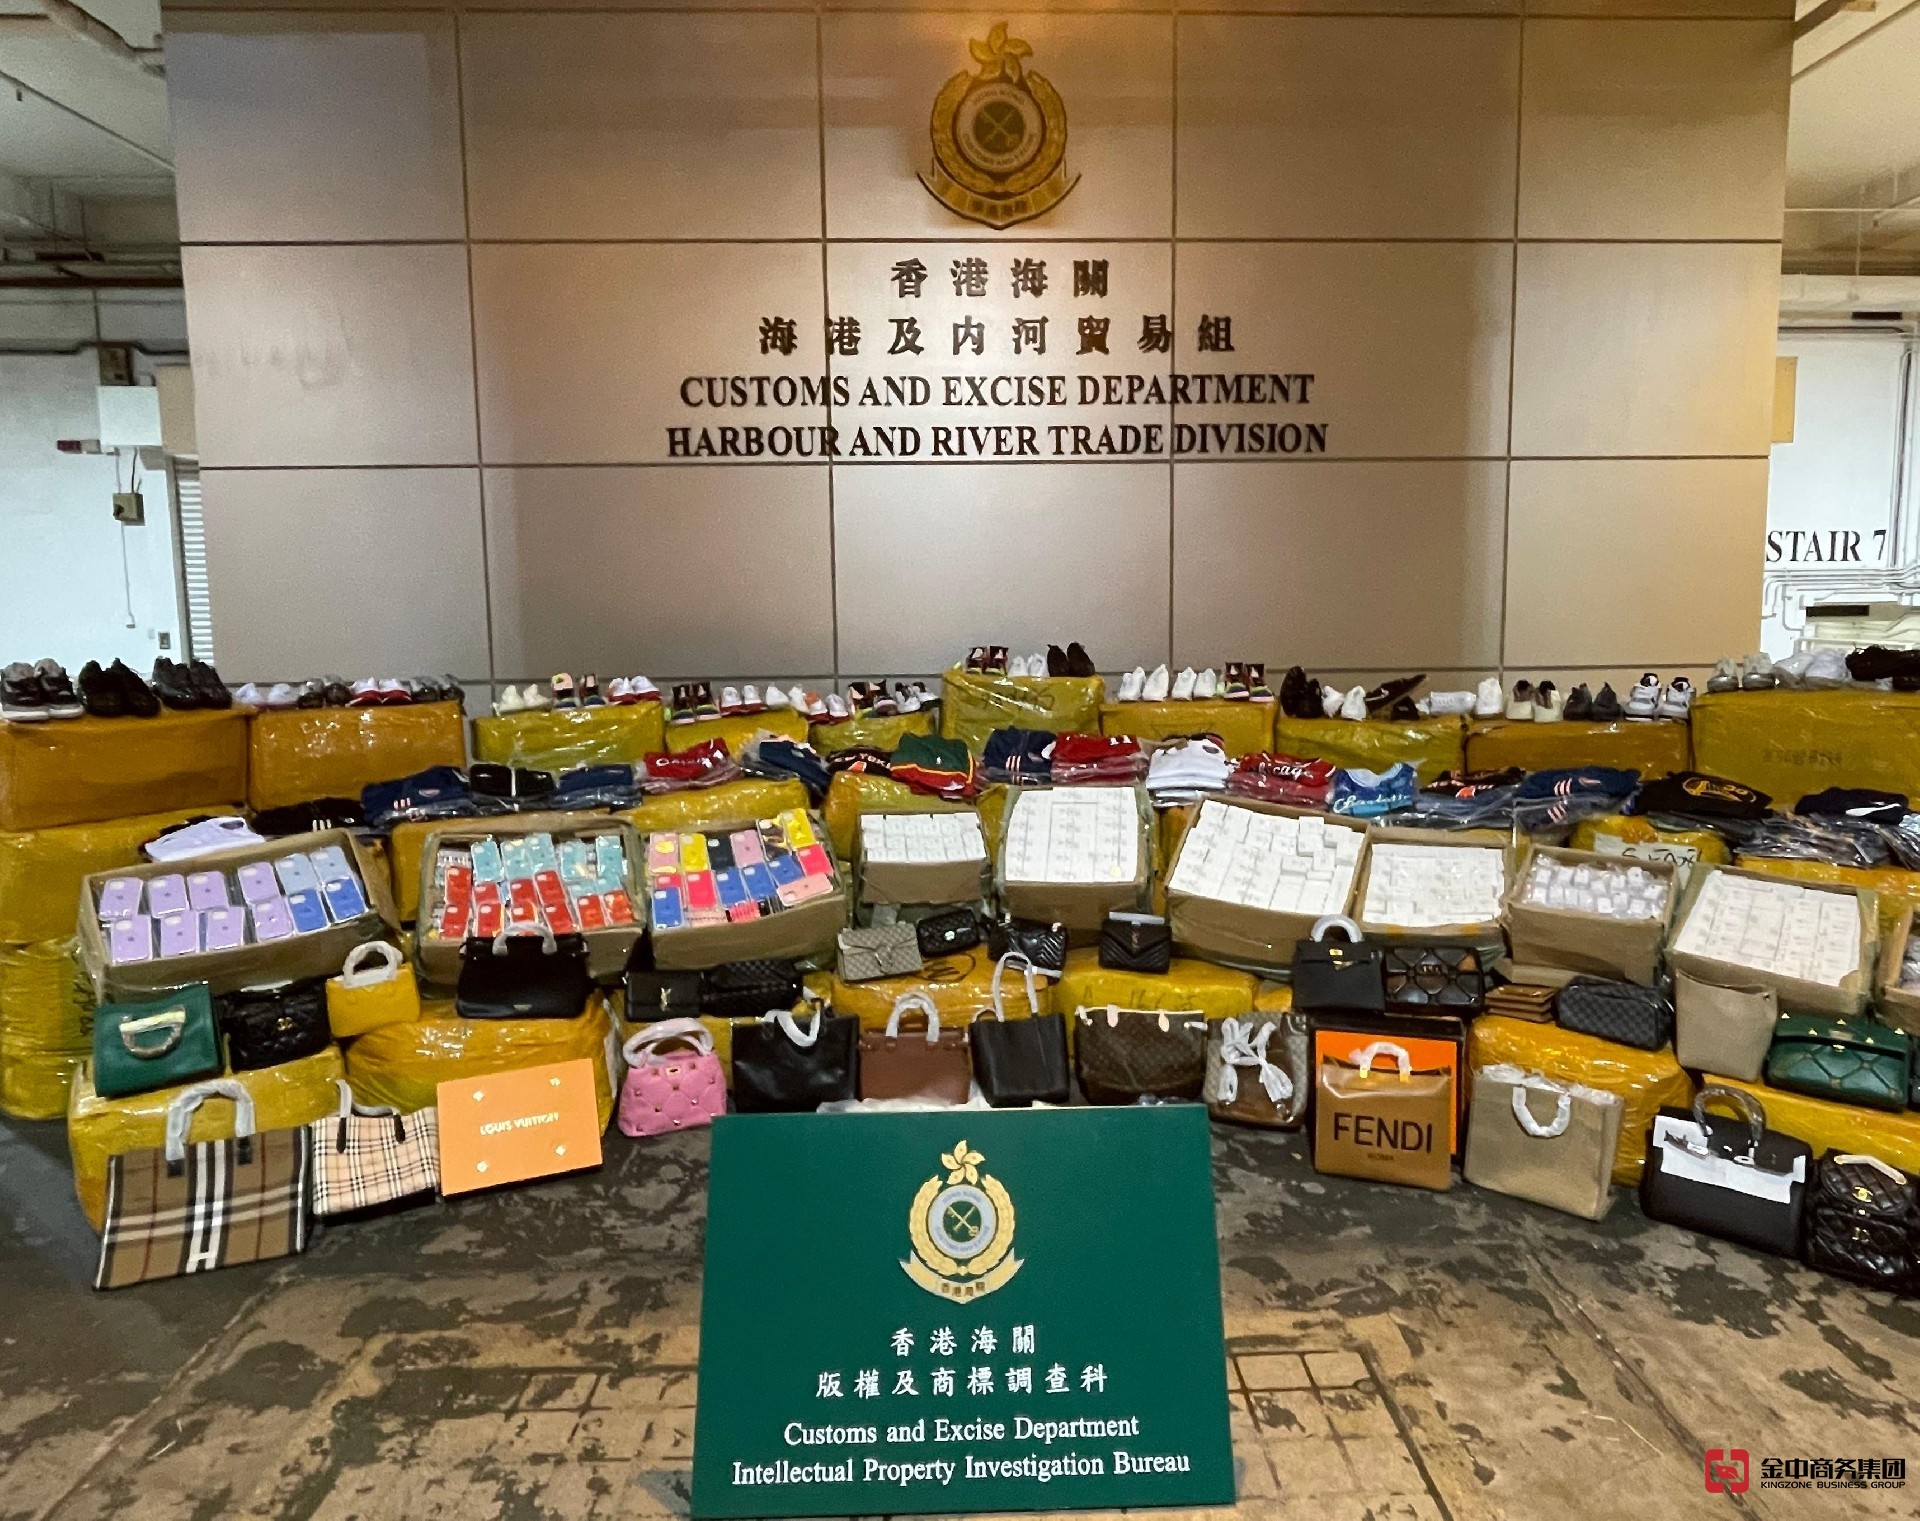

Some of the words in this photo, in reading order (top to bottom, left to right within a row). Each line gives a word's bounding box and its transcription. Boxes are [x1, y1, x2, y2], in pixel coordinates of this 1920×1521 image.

[891, 257, 1109, 298] 香港海關
[680, 375, 849, 407] CUSTOMS
[858, 375, 931, 406] AND
[941, 375, 1067, 406] EXCISE
[1077, 373, 1315, 405] DEPARTMENT
[666, 426, 842, 457] HARBOUR
[849, 425, 921, 456] AND
[931, 425, 1040, 456] RIVER
[1048, 424, 1163, 455] TRADE
[1174, 423, 1329, 453] DIVISION
[1766, 530, 1863, 562] STAIR
[1872, 529, 1887, 561] 7
[480, 1119, 513, 1136] LOUIS
[1334, 1112, 1433, 1154] FENDI
[890, 1324, 1035, 1357] 香港海關
[815, 1362, 1108, 1400] 版權及商標調查科
[783, 1422, 877, 1446] Customs
[886, 1418, 925, 1443] and
[933, 1417, 1006, 1442] Excise
[1013, 1415, 1140, 1445] Department
[731, 1458, 854, 1486] Intellectual
[862, 1457, 956, 1487] Property
[965, 1452, 1105, 1483] Investigation
[1112, 1451, 1191, 1475] Bureau
